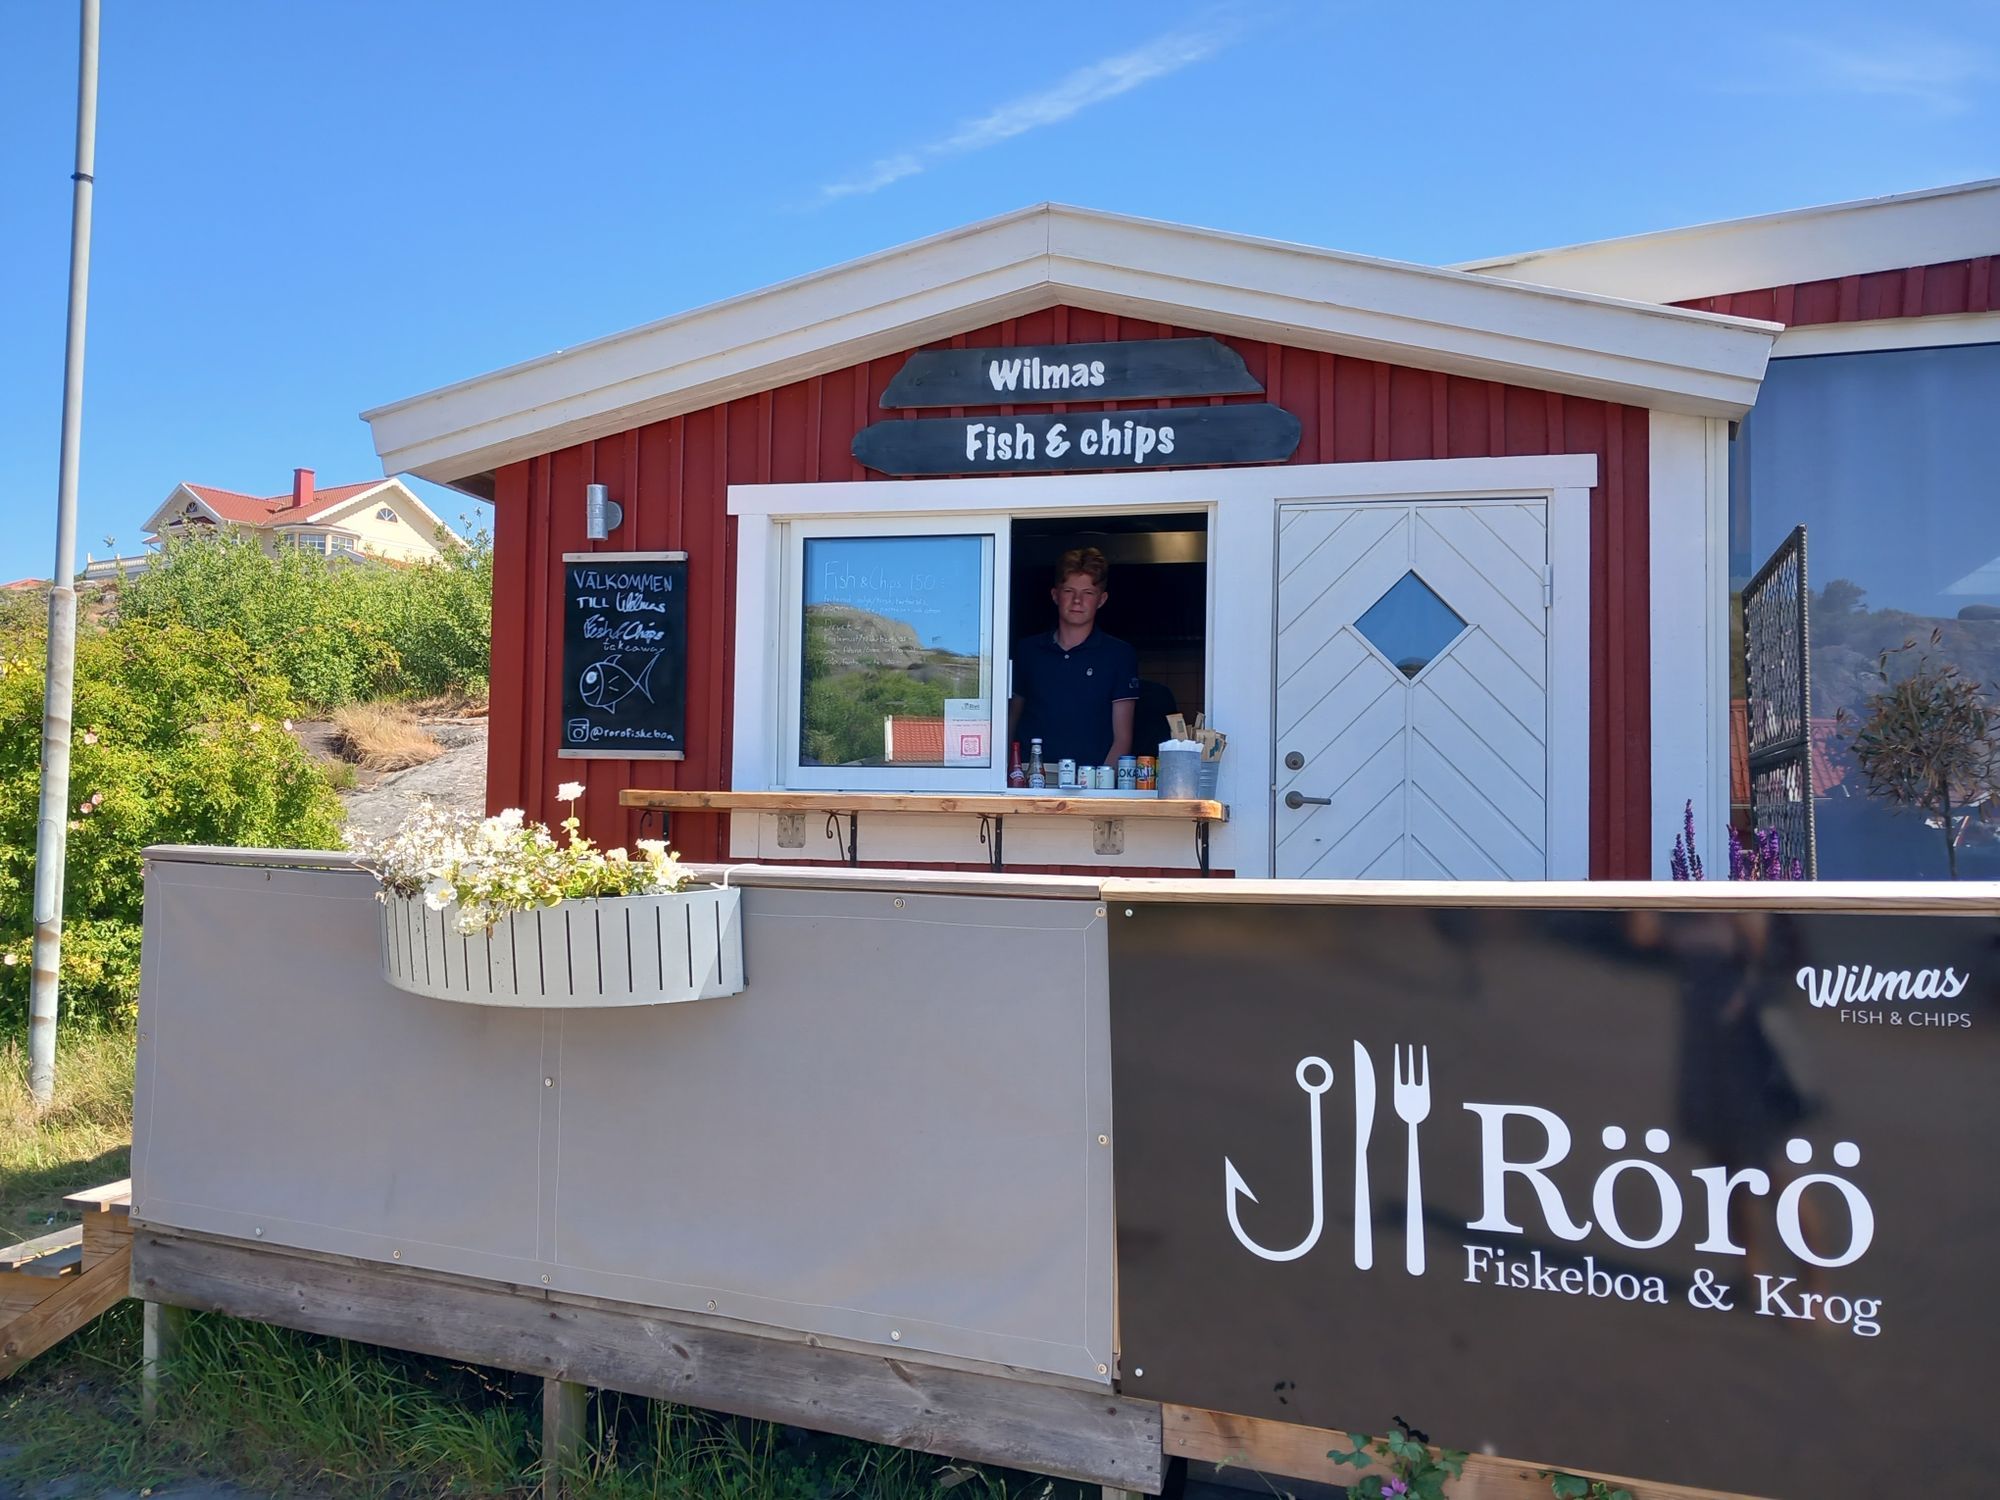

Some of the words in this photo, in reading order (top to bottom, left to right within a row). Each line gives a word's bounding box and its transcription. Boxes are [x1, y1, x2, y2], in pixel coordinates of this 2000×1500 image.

[989, 357, 1105, 391] Wilmas
[966, 423, 1035, 461] Fish
[1045, 423, 1070, 457] &
[1080, 419, 1175, 464] chips
[574, 570, 673, 593] VÄLKOMMEN
[824, 560, 856, 591] Fish
[576, 596, 610, 610] TILL
[603, 638, 665, 655] takeaway
[623, 621, 665, 644] Chips
[1796, 964, 1970, 1008] Wilmas
[1840, 1009, 1883, 1025] FISH
[1890, 1010, 1903, 1026] &
[1908, 1011, 1972, 1029] CHIPS
[1463, 1101, 1875, 1268] Rörö
[1462, 1244, 1669, 1305] Fiskeboa
[1688, 1268, 1735, 1312] &
[1753, 1273, 1882, 1338] Krog
